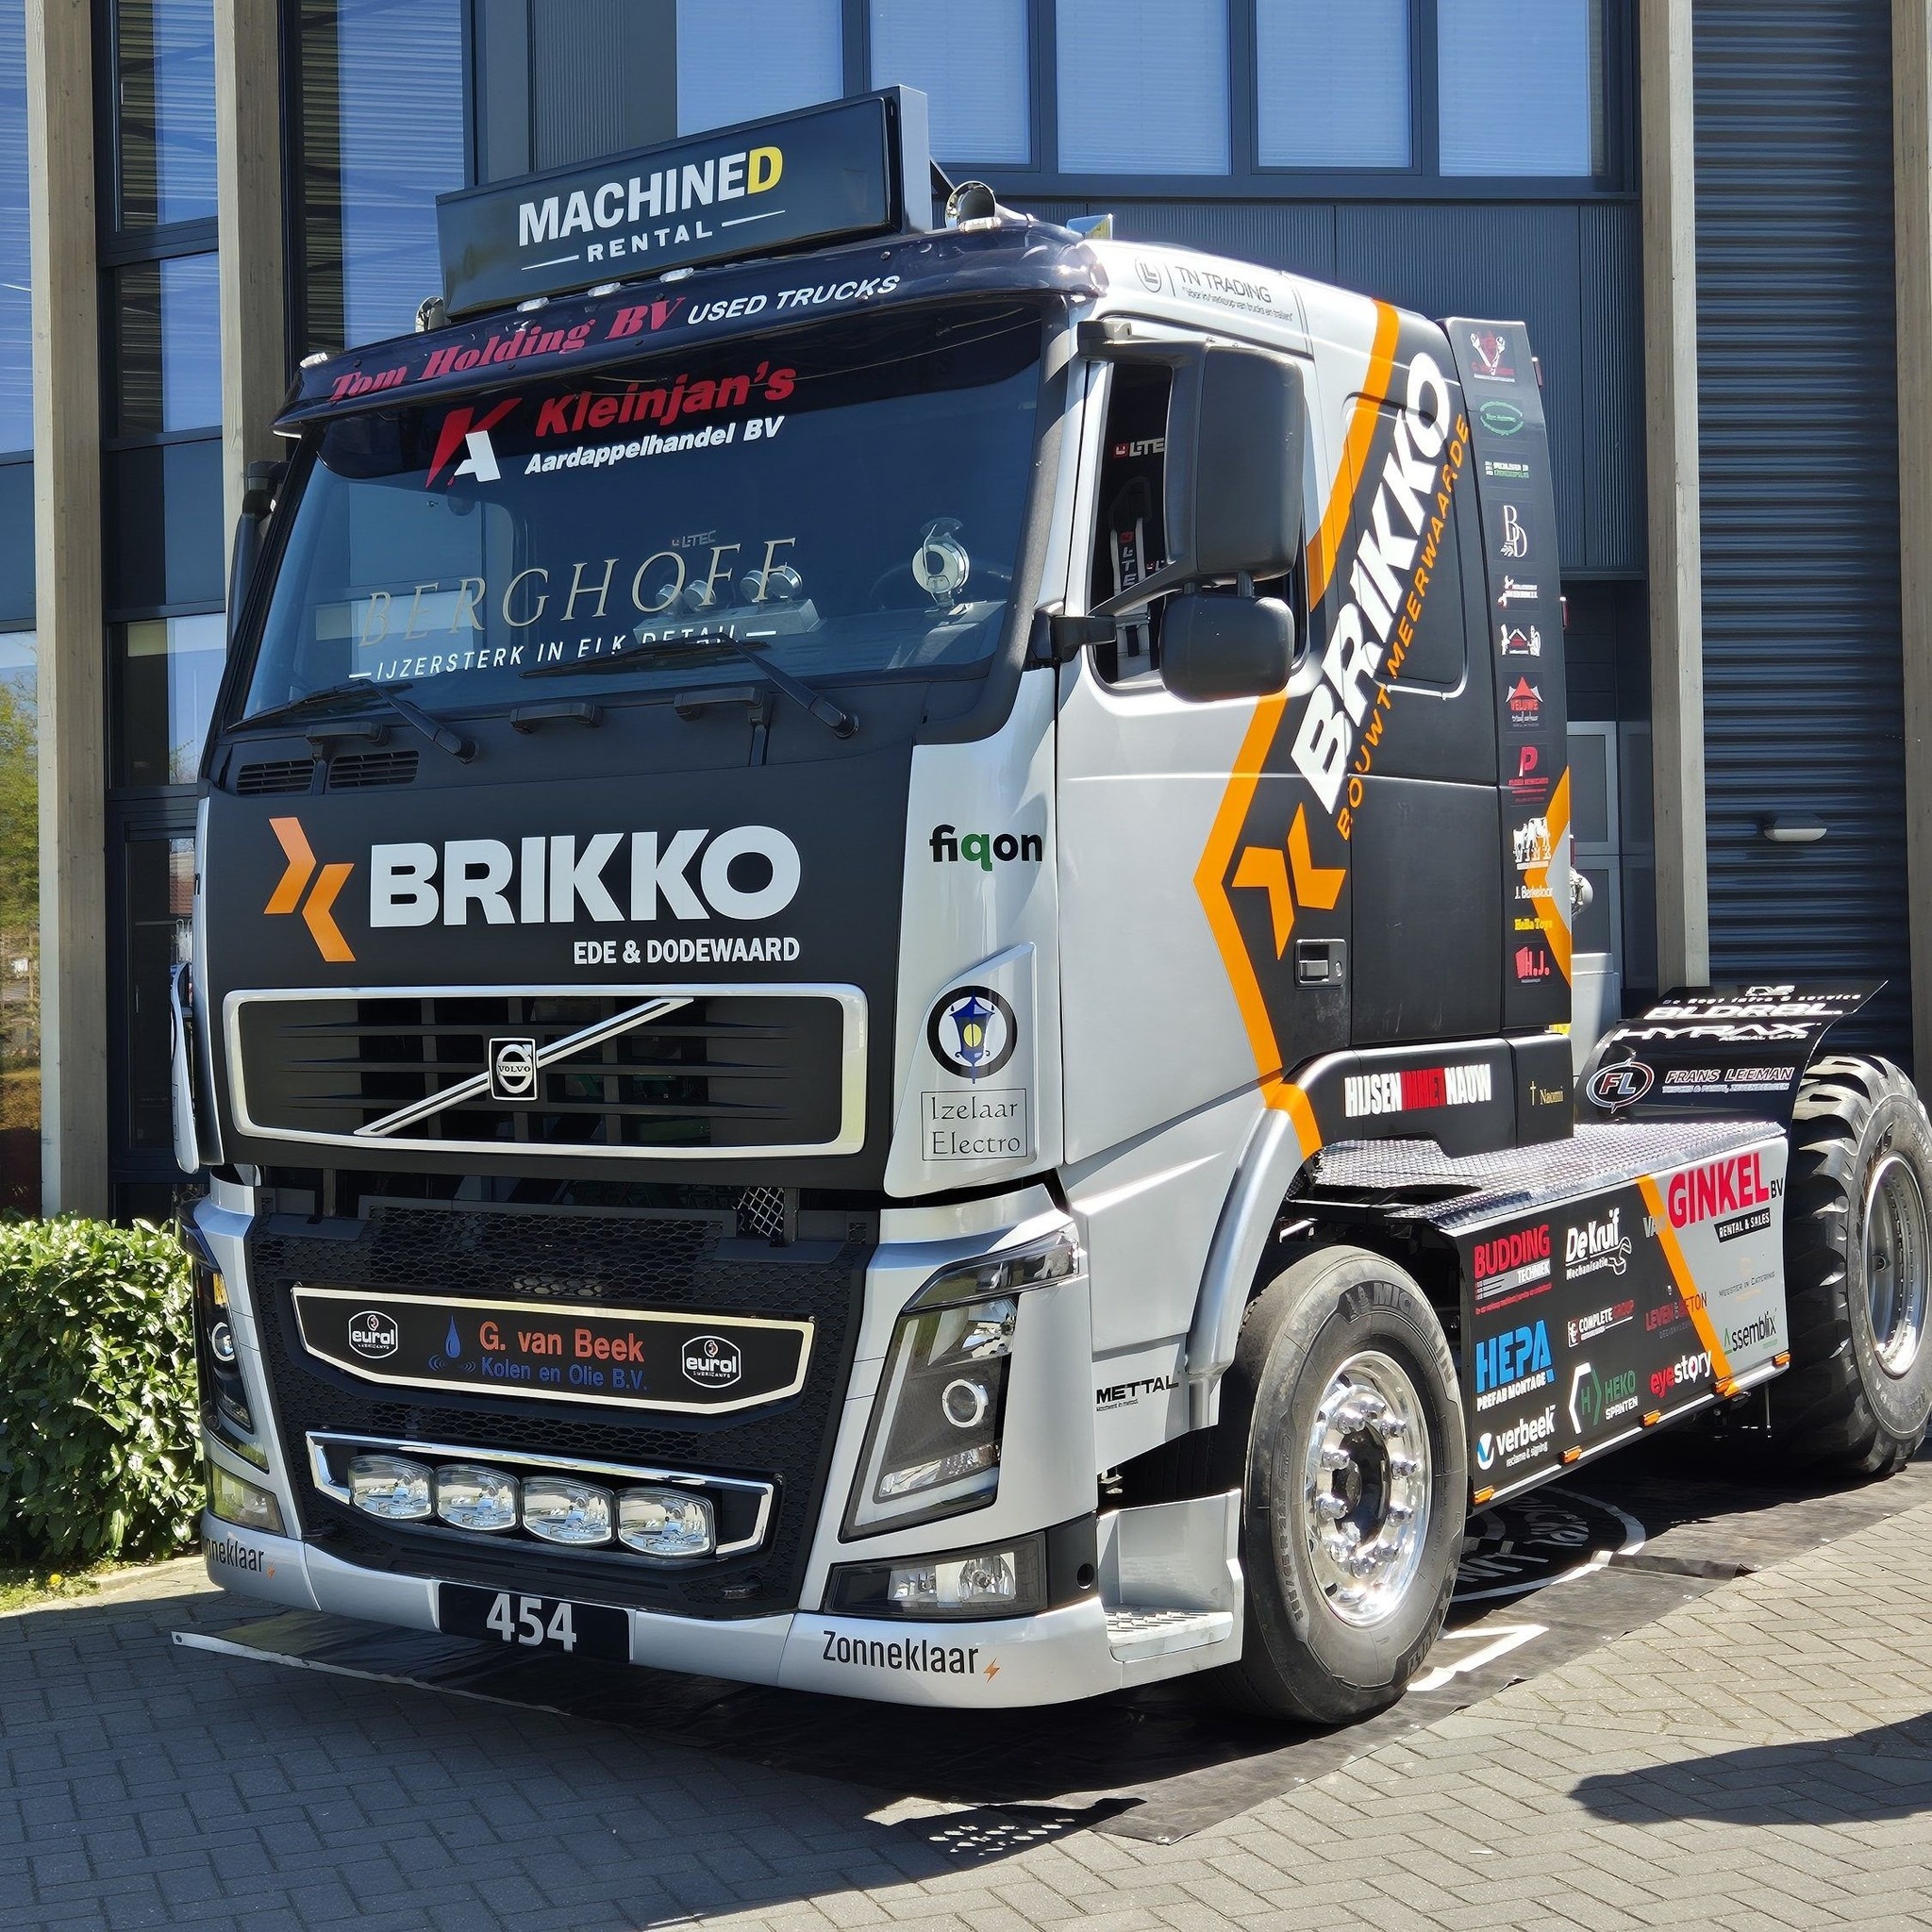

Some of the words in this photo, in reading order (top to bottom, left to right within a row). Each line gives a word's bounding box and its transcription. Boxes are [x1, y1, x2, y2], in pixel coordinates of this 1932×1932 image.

[518, 145, 784, 247] MACHINED
[586, 220, 713, 263] RENTAL
[1174, 265, 1201, 287] TN
[1201, 272, 1273, 303] TRADING
[330, 365, 408, 404] Tom
[418, 318, 596, 381] Holding
[604, 296, 686, 341] BV
[687, 294, 768, 325] USED
[775, 275, 901, 310] TRUCKS
[534, 360, 797, 437] Kleinjan's
[524, 422, 737, 475] Aardappelhandel
[742, 415, 787, 442] BV
[358, 536, 797, 648] BERGHOFF
[1291, 351, 1452, 815] BRIKKO
[1336, 681, 1394, 841] BOUWT
[1387, 412, 1471, 681] MEERWAARDE
[376, 645, 524, 681] IJZERSTERK
[538, 641, 566, 662] IN
[928, 823, 1043, 873] fiqon
[369, 824, 802, 928] BRIKKO
[573, 939, 618, 966] EDE
[622, 941, 641, 965] &
[646, 937, 802, 965] DODEWAARD
[497, 1063, 532, 1074] VOLVO
[1599, 1071, 1638, 1096] FL
[1664, 1067, 1722, 1084] FRANS
[1724, 1066, 1796, 1083] LEEMAN
[930, 1095, 1019, 1121] Izelaar
[931, 1129, 1021, 1155] Electro
[1666, 1152, 1774, 1230] GINKEL
[1770, 1177, 1785, 1200] BV
[1718, 1220, 1744, 1239] RENTAL
[1750, 1211, 1771, 1228] SALES
[1474, 1224, 1551, 1279] BUDDING
[351, 1328, 396, 1345] eurol
[478, 1320, 507, 1351] G.
[517, 1330, 563, 1356] van
[574, 1327, 646, 1363] Beek
[1475, 1319, 1553, 1394] HEPA
[481, 1356, 532, 1380] Kolen
[539, 1367, 561, 1383] en
[568, 1363, 605, 1387] Olie
[611, 1367, 649, 1391] B.V.
[686, 1355, 737, 1374] eurol
[1648, 1350, 1713, 1399] eyestory
[1095, 1374, 1180, 1406] METTAL
[1476, 1387, 1508, 1412] PREFAB
[1507, 1371, 1547, 1401] MONTAGE
[1604, 1369, 1637, 1405] HEKO
[1495, 1404, 1557, 1457] verbeek
[205, 1537, 266, 1574] nneklaar
[484, 1591, 578, 1655] 454
[823, 1627, 981, 1676] Zonneklaar
